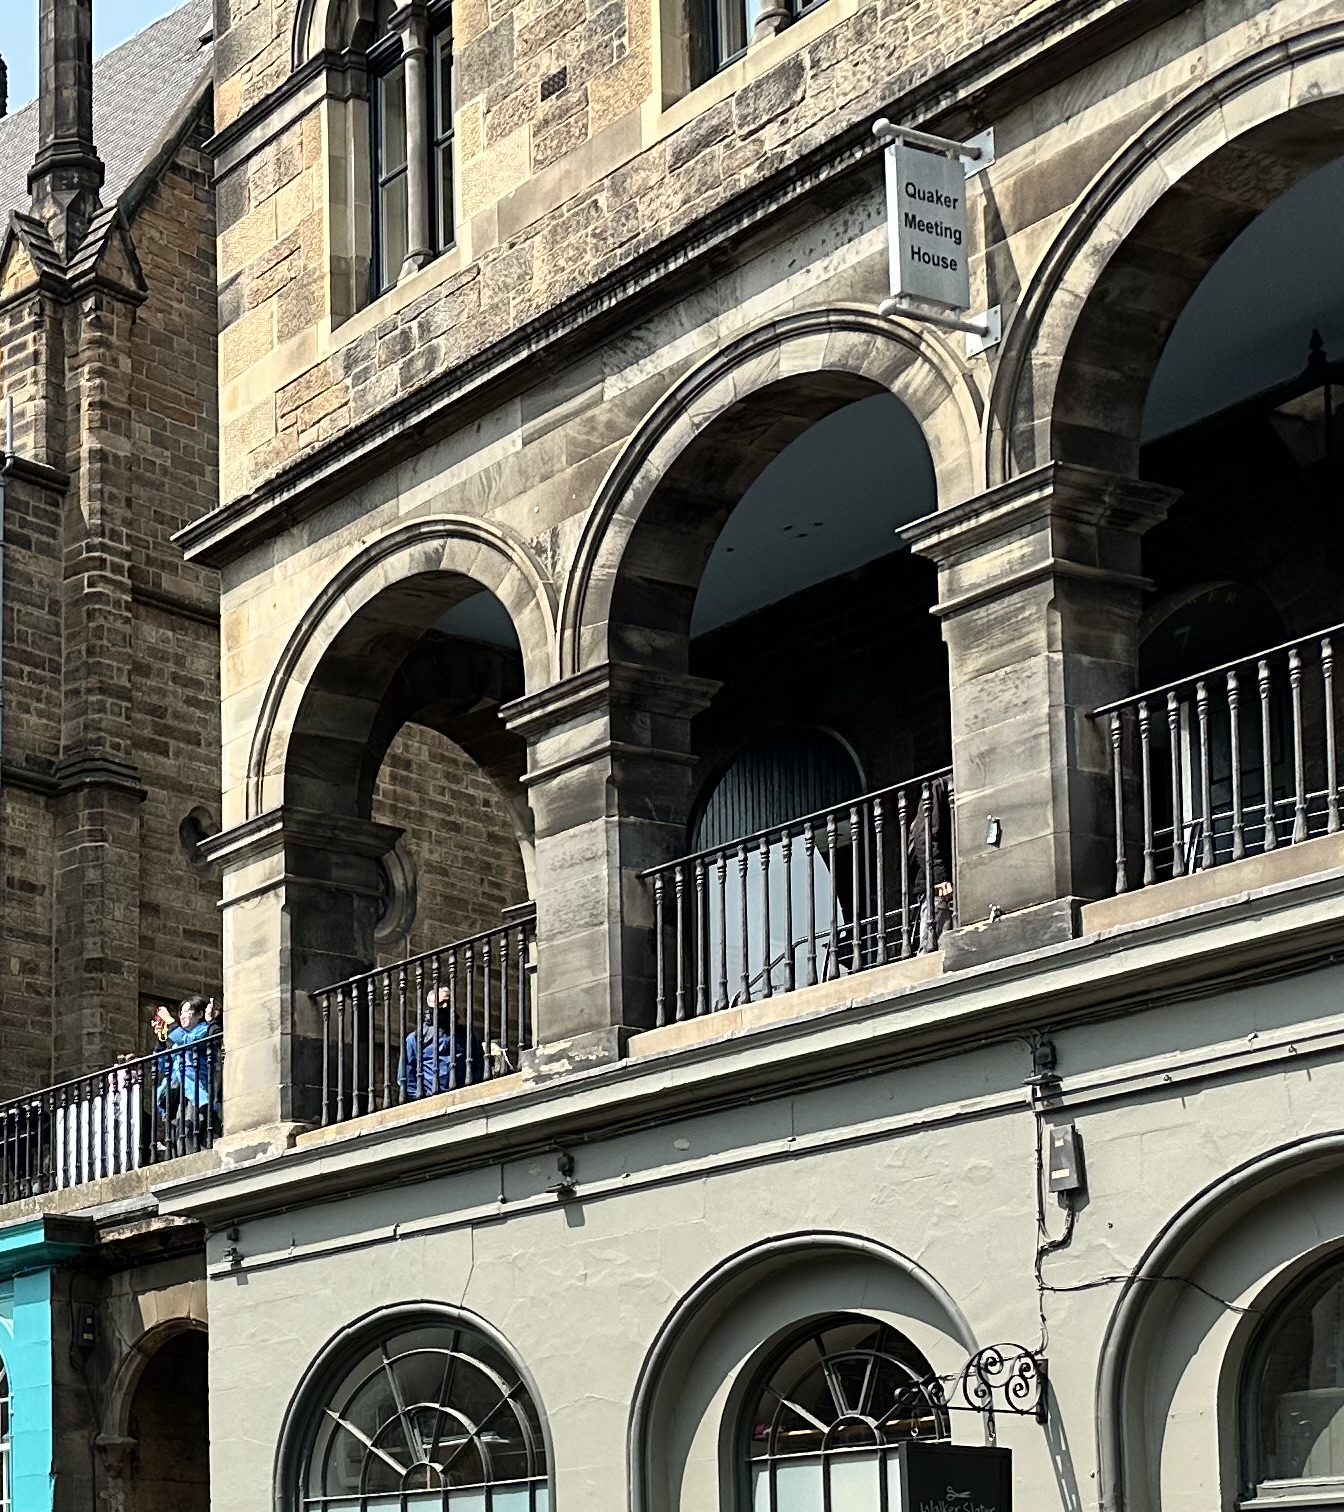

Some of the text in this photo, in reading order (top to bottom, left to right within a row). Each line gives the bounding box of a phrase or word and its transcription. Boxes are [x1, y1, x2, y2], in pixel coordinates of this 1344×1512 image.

[905, 182, 959, 210] Quaker
[904, 212, 962, 245] Meeting
[911, 245, 958, 271] House
